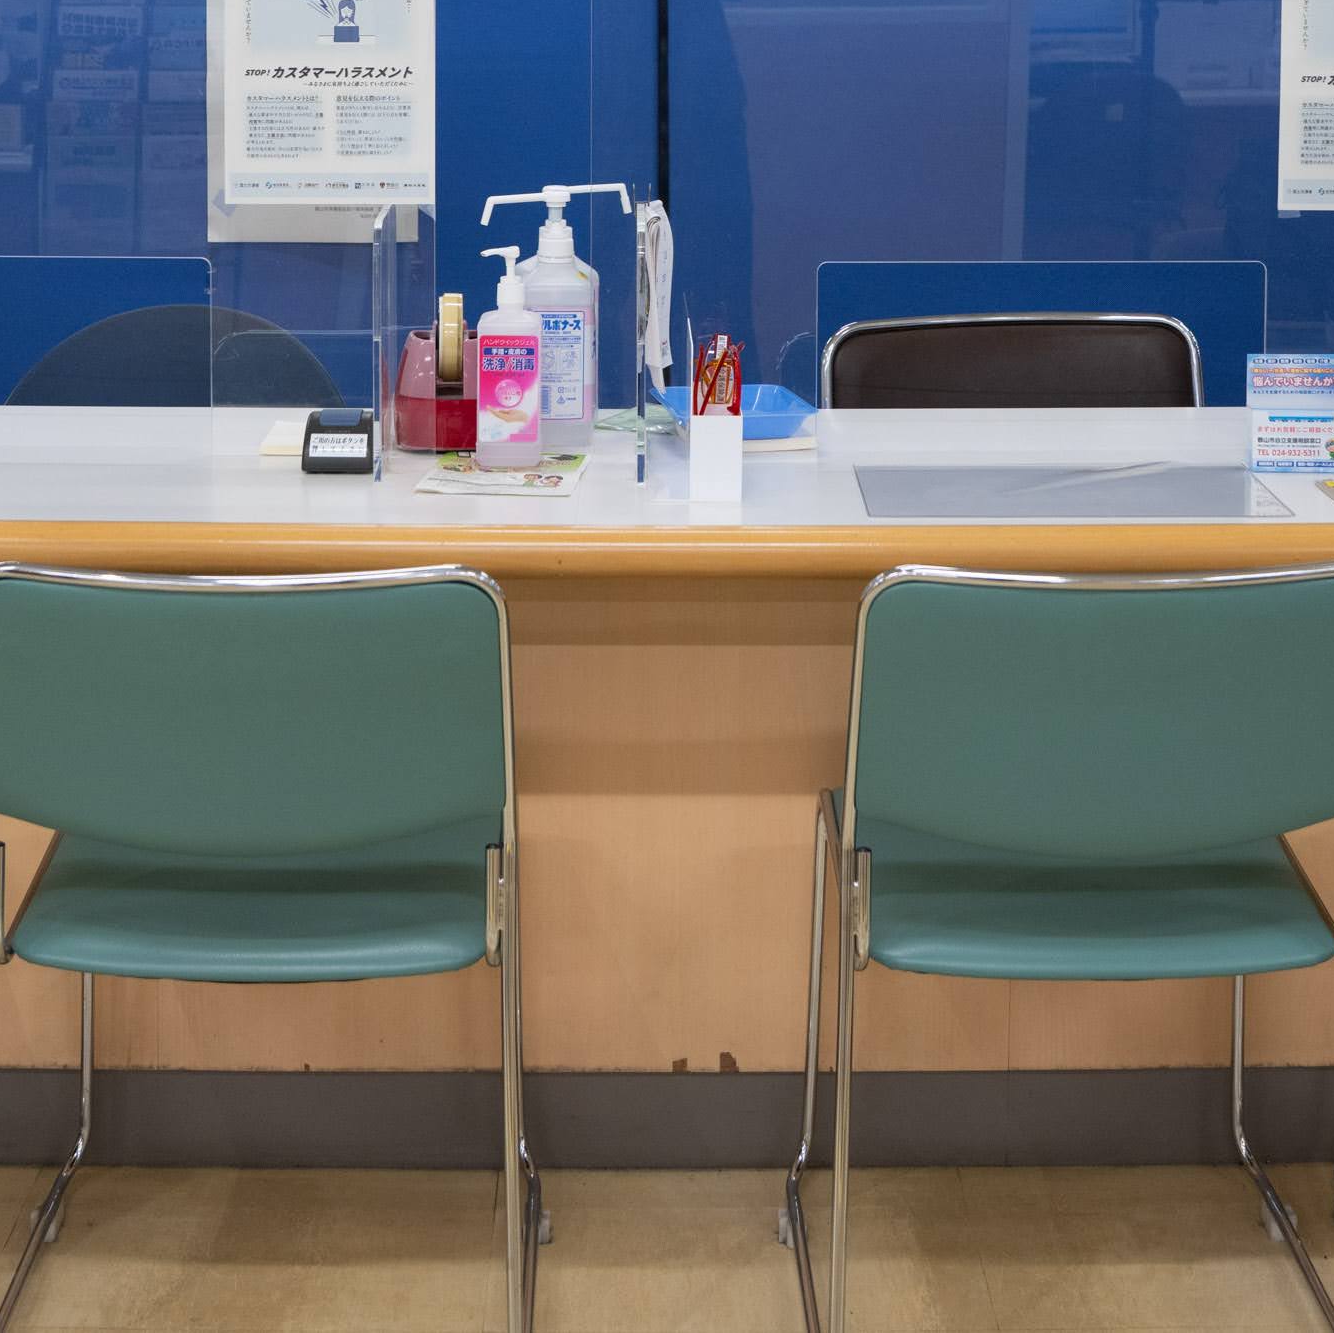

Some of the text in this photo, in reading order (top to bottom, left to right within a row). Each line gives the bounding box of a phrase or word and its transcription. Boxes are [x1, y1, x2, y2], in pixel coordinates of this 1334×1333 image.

[271, 66, 413, 79] カスタマーハラスメント
[1300, 75, 1327, 83] STOP!
[542, 320, 581, 330] ルボナース
